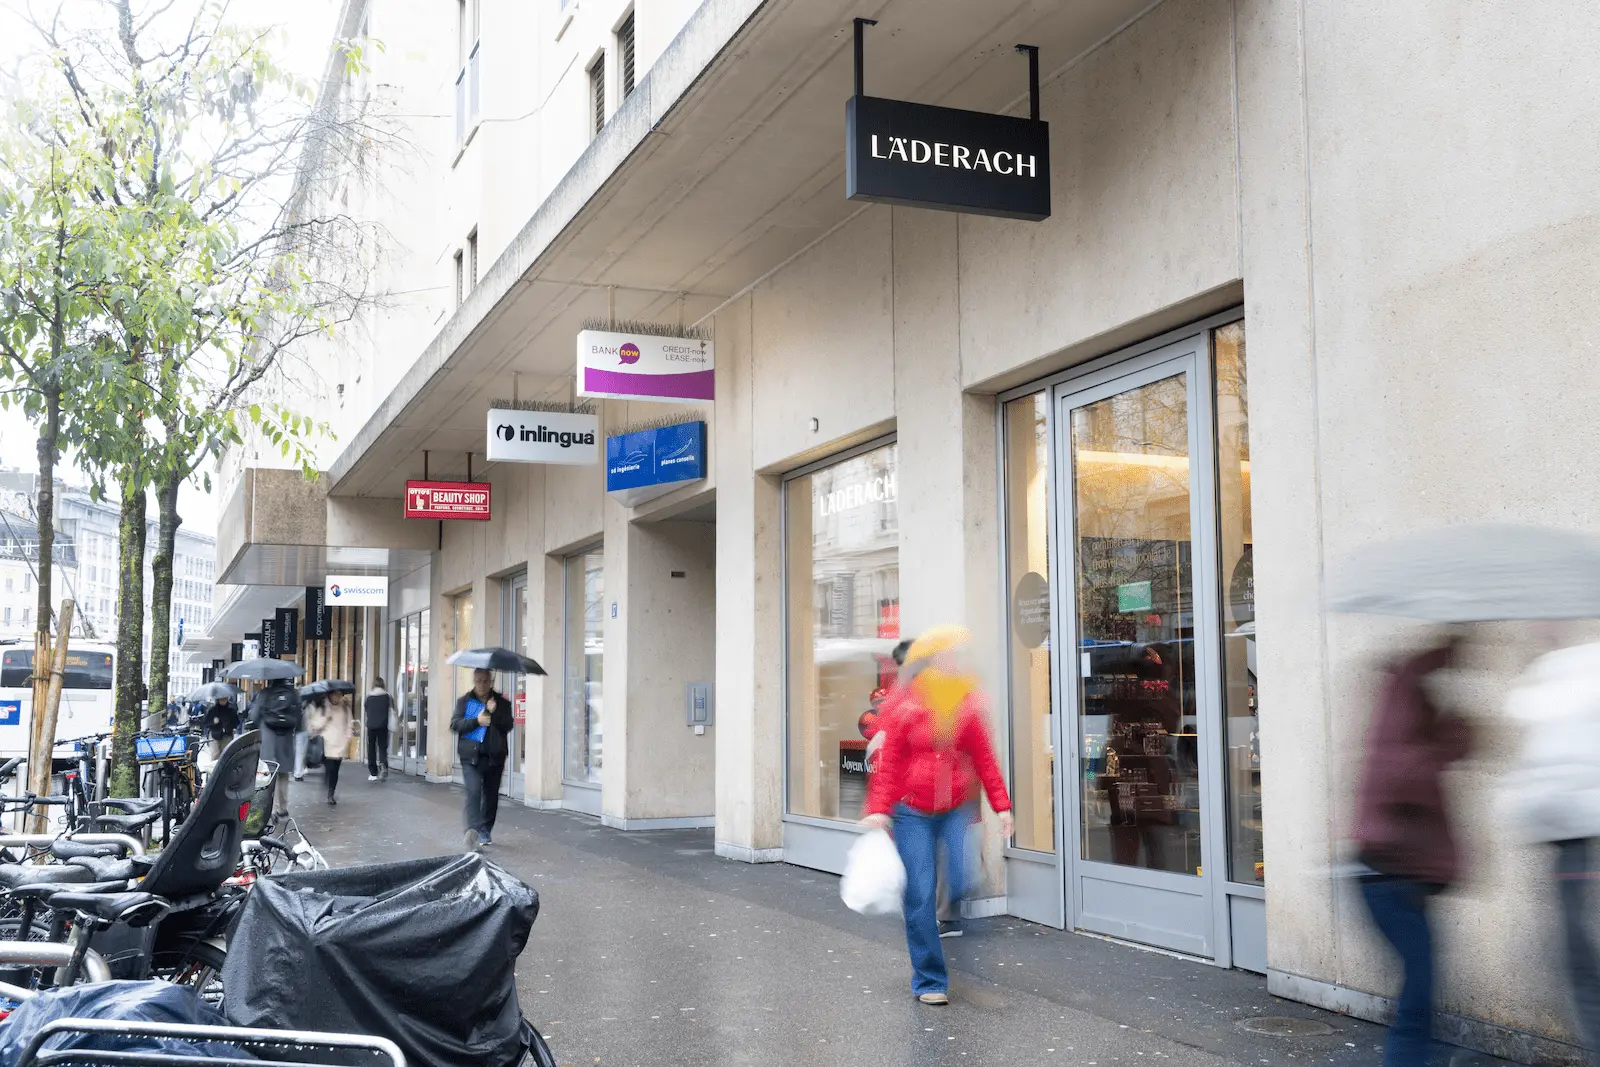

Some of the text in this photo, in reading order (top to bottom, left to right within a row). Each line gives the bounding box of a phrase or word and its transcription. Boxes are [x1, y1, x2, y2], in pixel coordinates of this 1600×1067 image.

[871, 134, 1036, 178] LÄDERACH
[592, 345, 639, 357] BANK now
[433, 491, 486, 504] BEAUTY SHOP
[820, 473, 896, 517] LÄDERACH
[343, 586, 384, 595] swisscom
[842, 755, 863, 774] Joyeux
